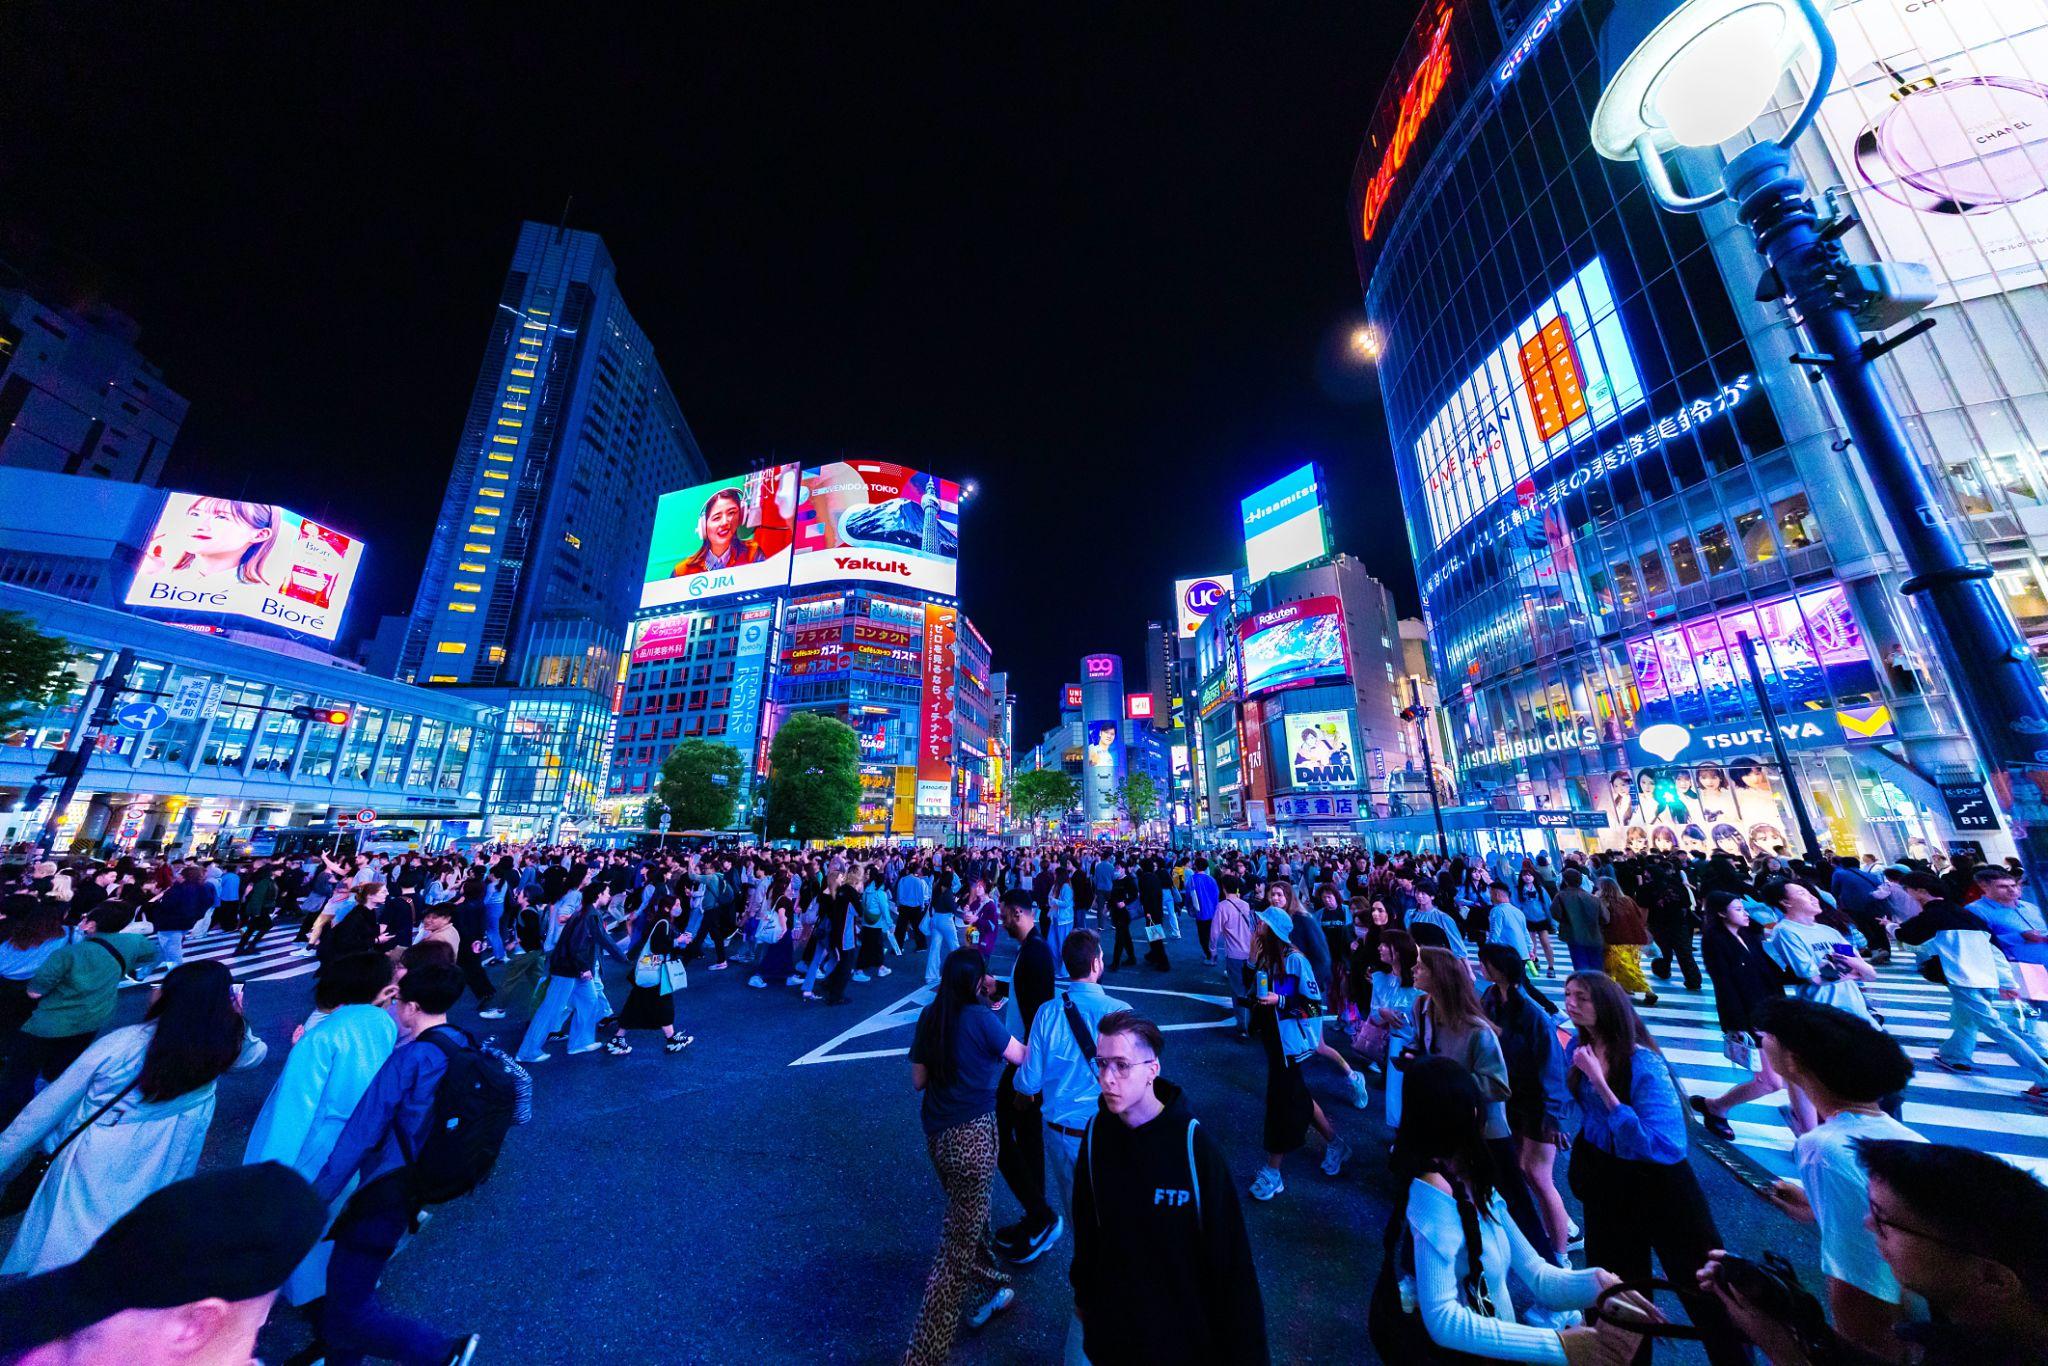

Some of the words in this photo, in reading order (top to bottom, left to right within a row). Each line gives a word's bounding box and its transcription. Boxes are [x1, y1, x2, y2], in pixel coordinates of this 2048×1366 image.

[1975, 121, 2033, 145] CHANEL
[871, 484, 899, 495] TOKIO
[1245, 483, 1318, 524] Hisamitsu
[834, 557, 912, 577] Yakult
[710, 575, 735, 590] JRA
[149, 582, 227, 605] Bioré
[261, 597, 325, 630] Bioré
[1259, 606, 1297, 624] Rakuten
[855, 627, 908, 643] コンタクト
[821, 645, 844, 655] ガスト
[892, 649, 917, 660] ガスト
[1087, 658, 1113, 676] 109
[1703, 722, 1824, 749] TSUTYA
[1470, 726, 1598, 768] STARBUCKS
[1295, 765, 1356, 783] DMM
[1961, 816, 1989, 825] B1F
[1154, 1187, 1190, 1206] FTP
